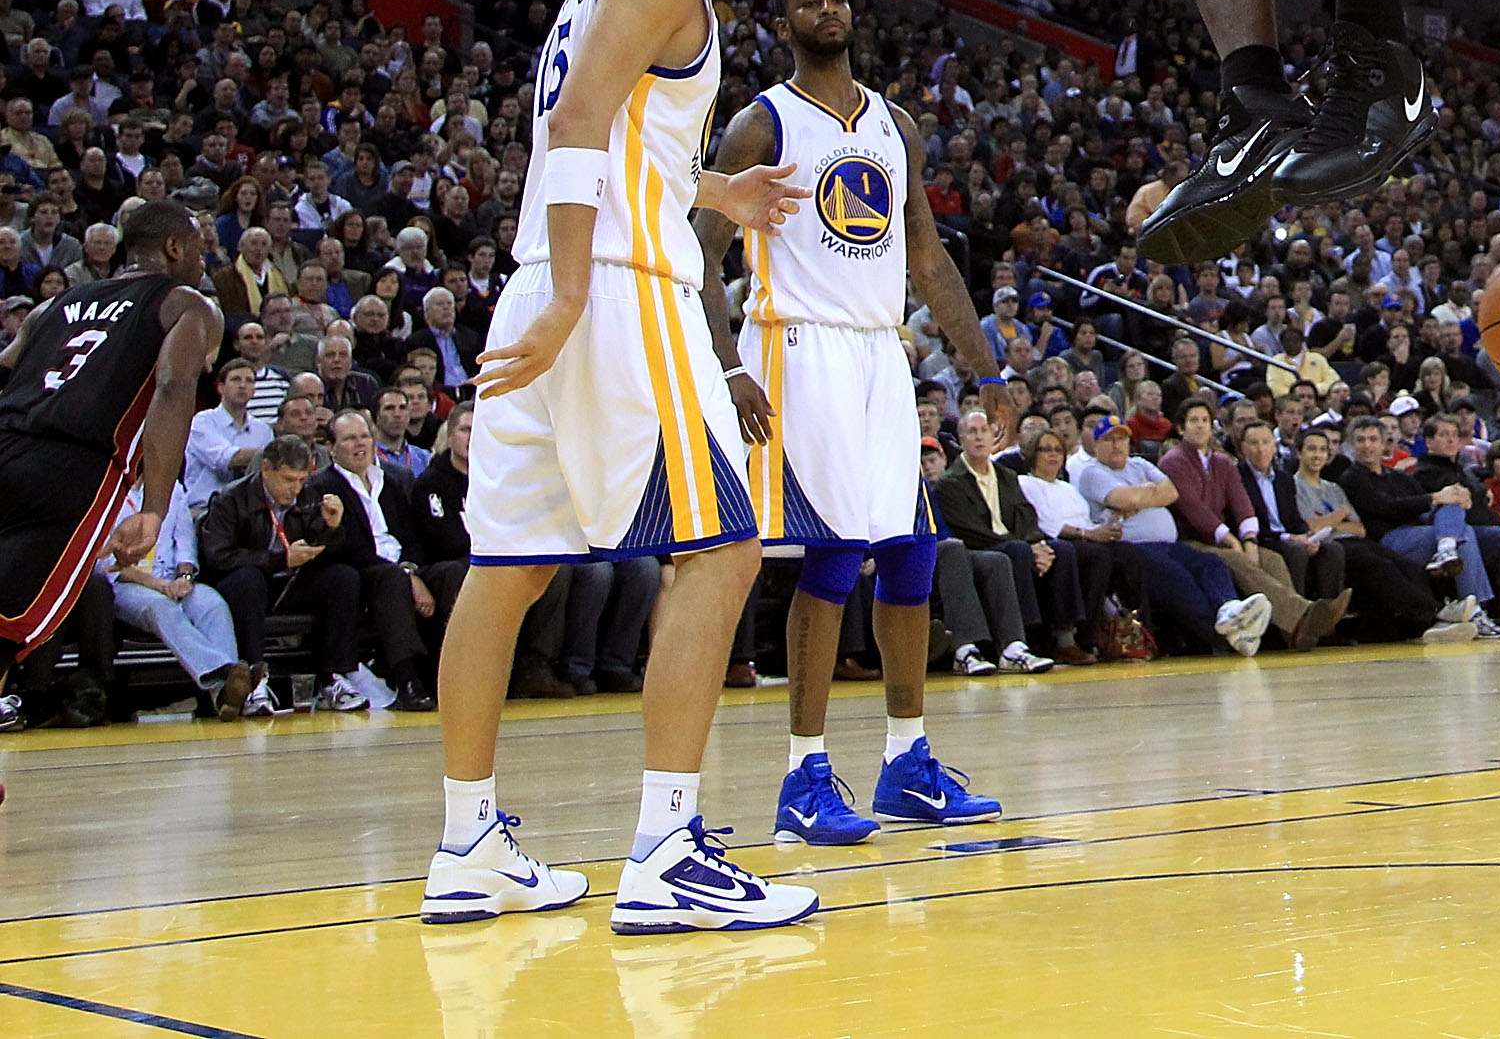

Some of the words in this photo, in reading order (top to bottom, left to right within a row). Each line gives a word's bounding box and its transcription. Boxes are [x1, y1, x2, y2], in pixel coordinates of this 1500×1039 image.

[537, 17, 572, 118] 15
[814, 146, 859, 175] GOLDEN
[863, 148, 897, 177] STATE
[861, 171, 871, 195] 1
[820, 230, 894, 261] WARRIORS
[63, 300, 134, 324] WADE
[43, 328, 109, 391] 3
